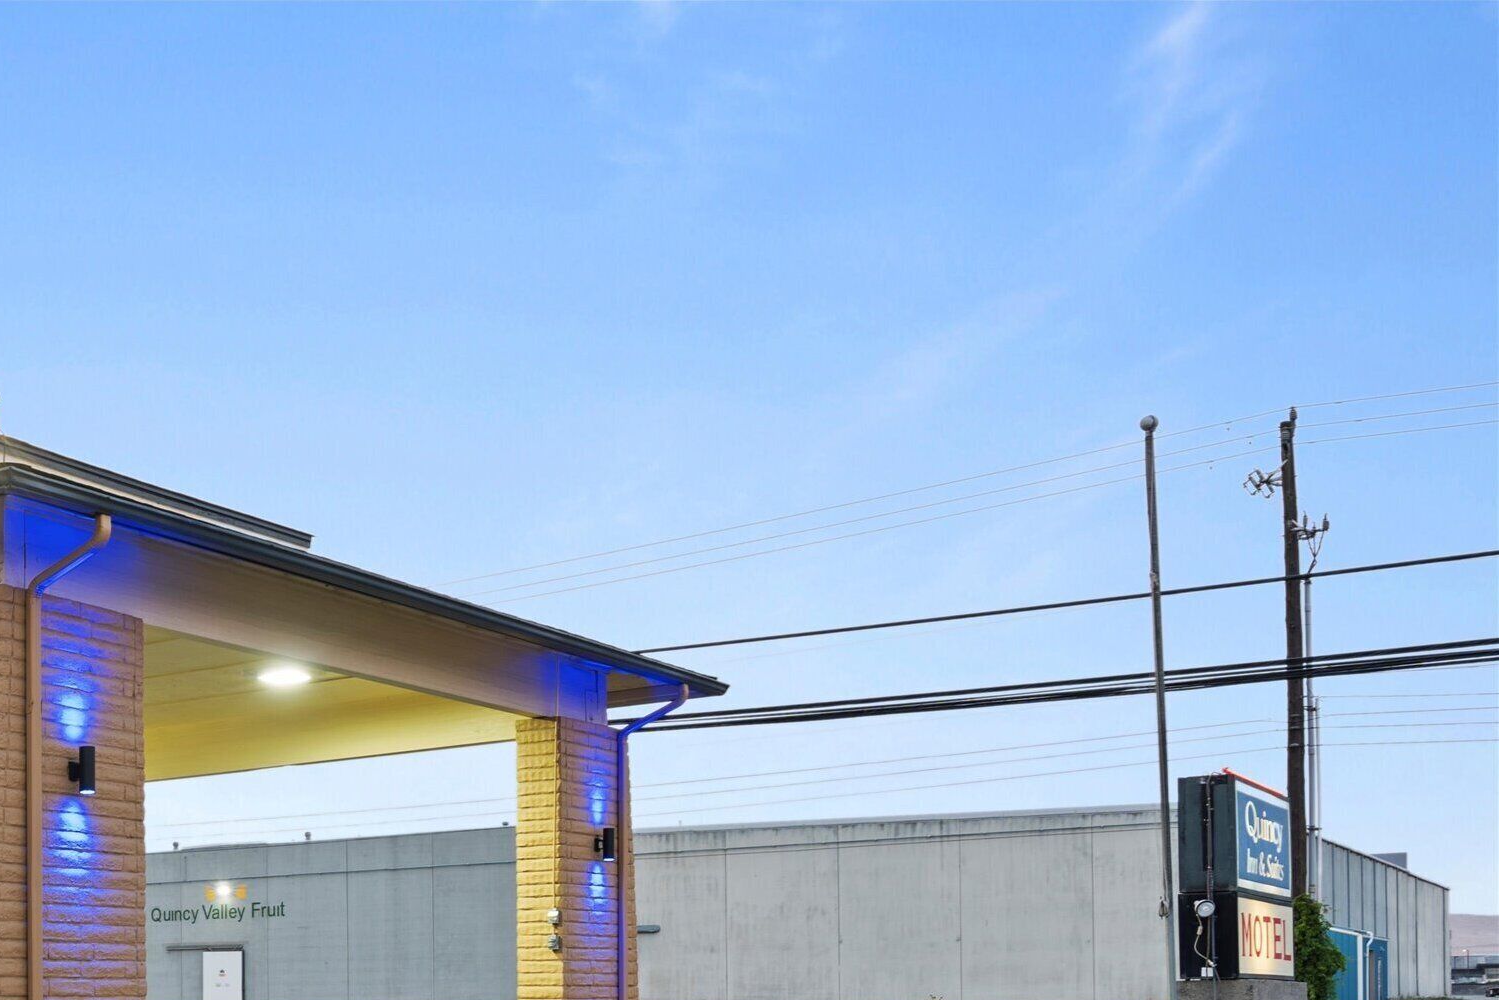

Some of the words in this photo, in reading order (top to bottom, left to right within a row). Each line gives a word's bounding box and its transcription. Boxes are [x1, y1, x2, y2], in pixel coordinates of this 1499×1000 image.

[1245, 800, 1284, 854] Quincy
[1247, 847, 1258, 875] Inn
[1258, 851, 1267, 877] &
[1267, 854, 1285, 881] Suites
[150, 907, 199, 924] Quincy
[202, 904, 246, 922] Valley
[251, 901, 286, 918] Fruit
[1240, 912, 1292, 962] MOTEL
